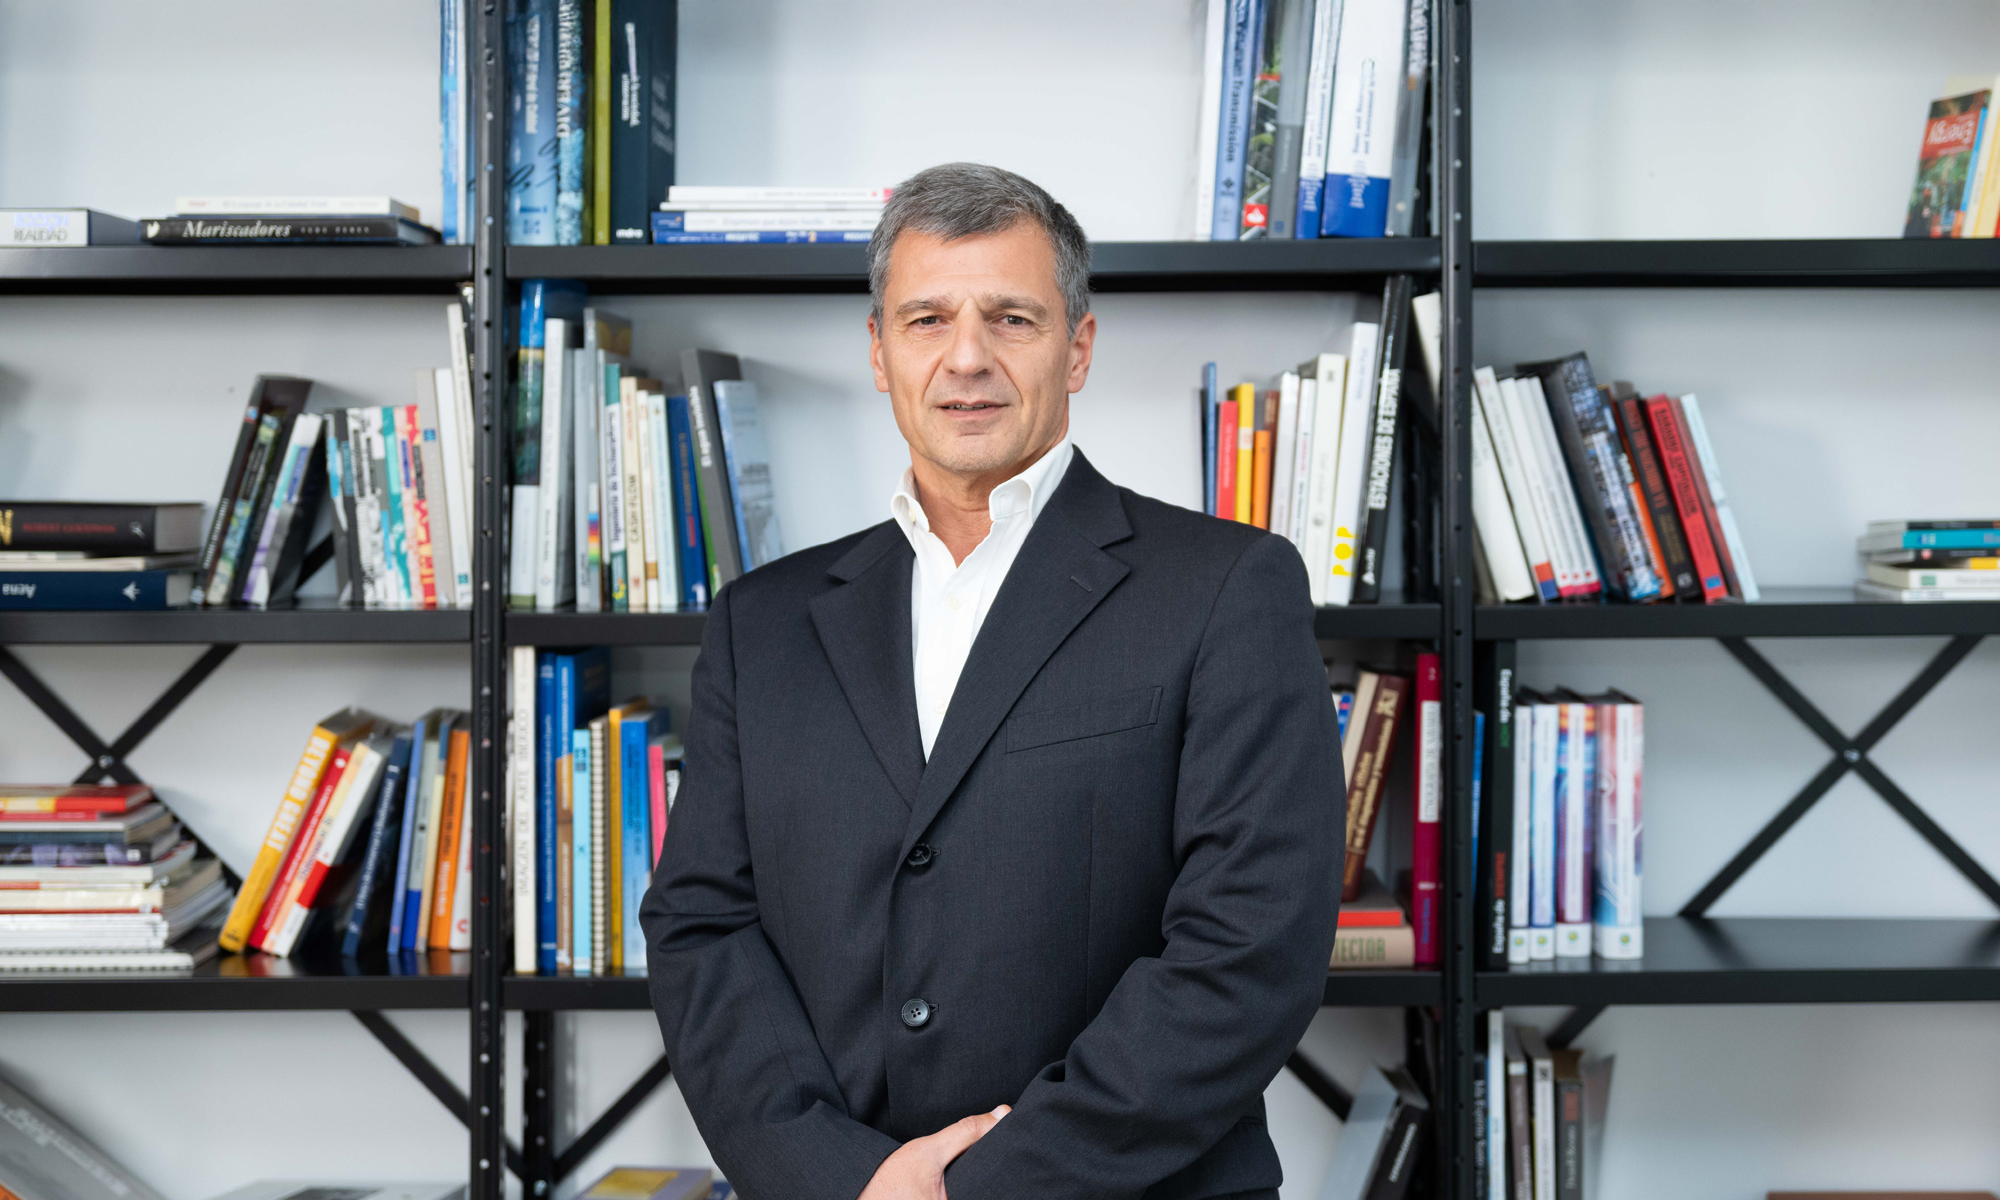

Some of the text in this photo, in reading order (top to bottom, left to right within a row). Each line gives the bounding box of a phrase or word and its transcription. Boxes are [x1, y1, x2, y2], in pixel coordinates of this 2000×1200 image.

[1226, 80, 1244, 163] Transmission
[14, 228, 69, 243] REALIDAD
[182, 220, 293, 239] Mariscadores
[1367, 368, 1401, 510] ESTACIONES DE ESPAÑA
[1332, 526, 1358, 577] POP
[2, 583, 37, 599] Aena
[1498, 668, 1513, 706] España
[1500, 706, 1511, 724] de
[287, 735, 331, 802] BEYOND
[266, 799, 302, 853] GREAT
[1494, 899, 1505, 914] de
[1493, 914, 1505, 954] España
